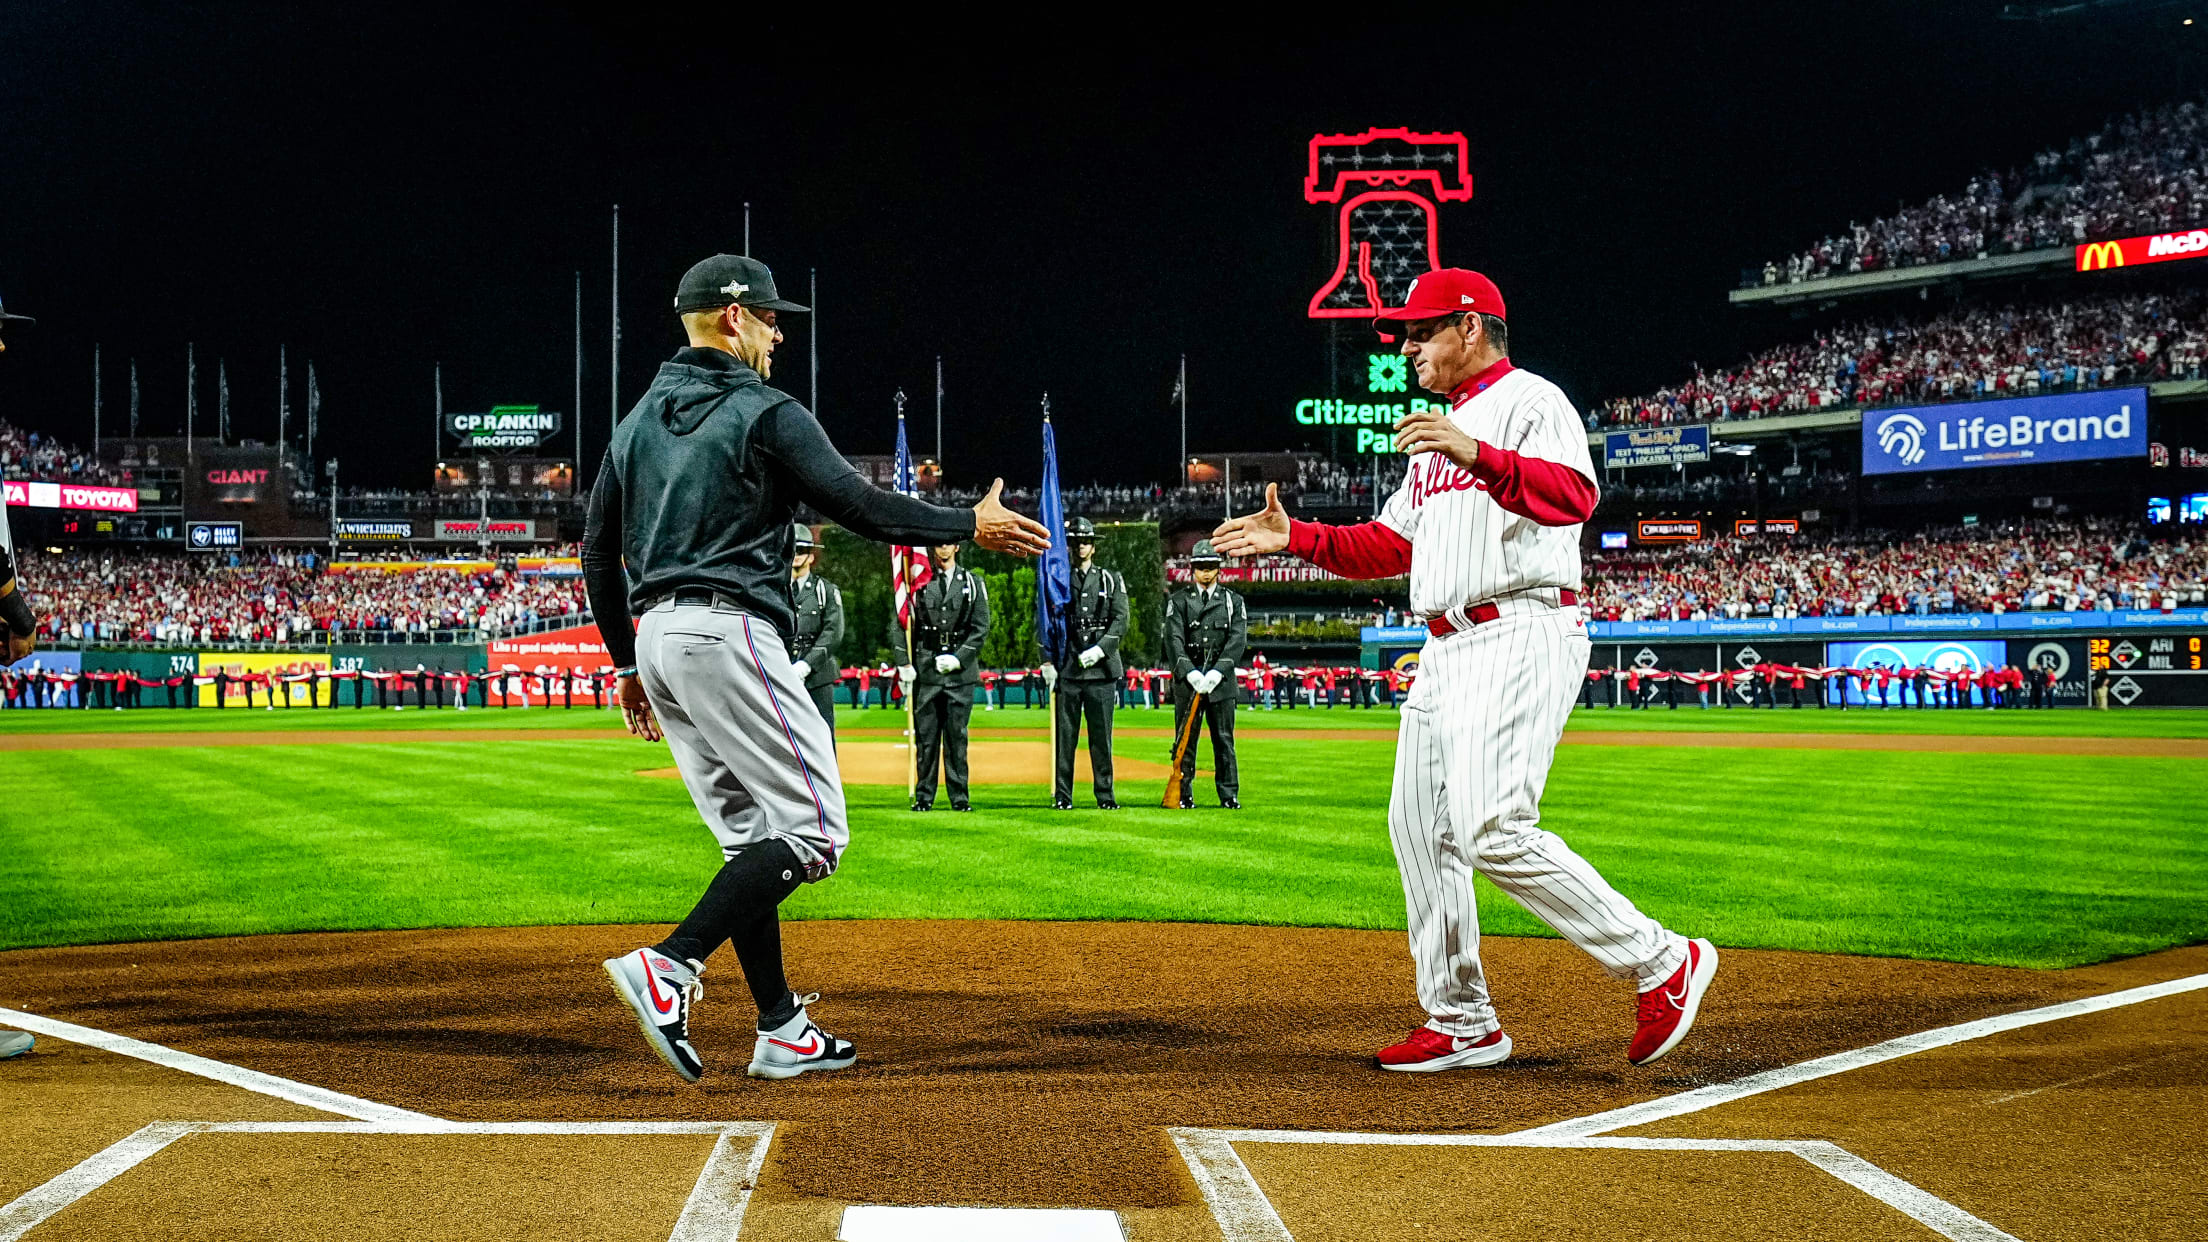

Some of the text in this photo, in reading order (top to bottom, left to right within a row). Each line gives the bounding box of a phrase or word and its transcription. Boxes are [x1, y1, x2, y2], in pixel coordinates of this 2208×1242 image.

[1295, 398, 1405, 424] Citizens
[1939, 405, 2131, 451] LifeBrand
[472, 435, 535, 446] ROOFTOP
[1357, 428, 1415, 453] Par
[208, 469, 268, 484] GIANT
[63, 488, 133, 508] TOYOTA
[2090, 638, 2200, 653] 32 ARI 0
[171, 656, 194, 672] 374
[339, 657, 364, 671] 387
[2148, 655, 2173, 669] MIL
[2190, 655, 2201, 669] 3
